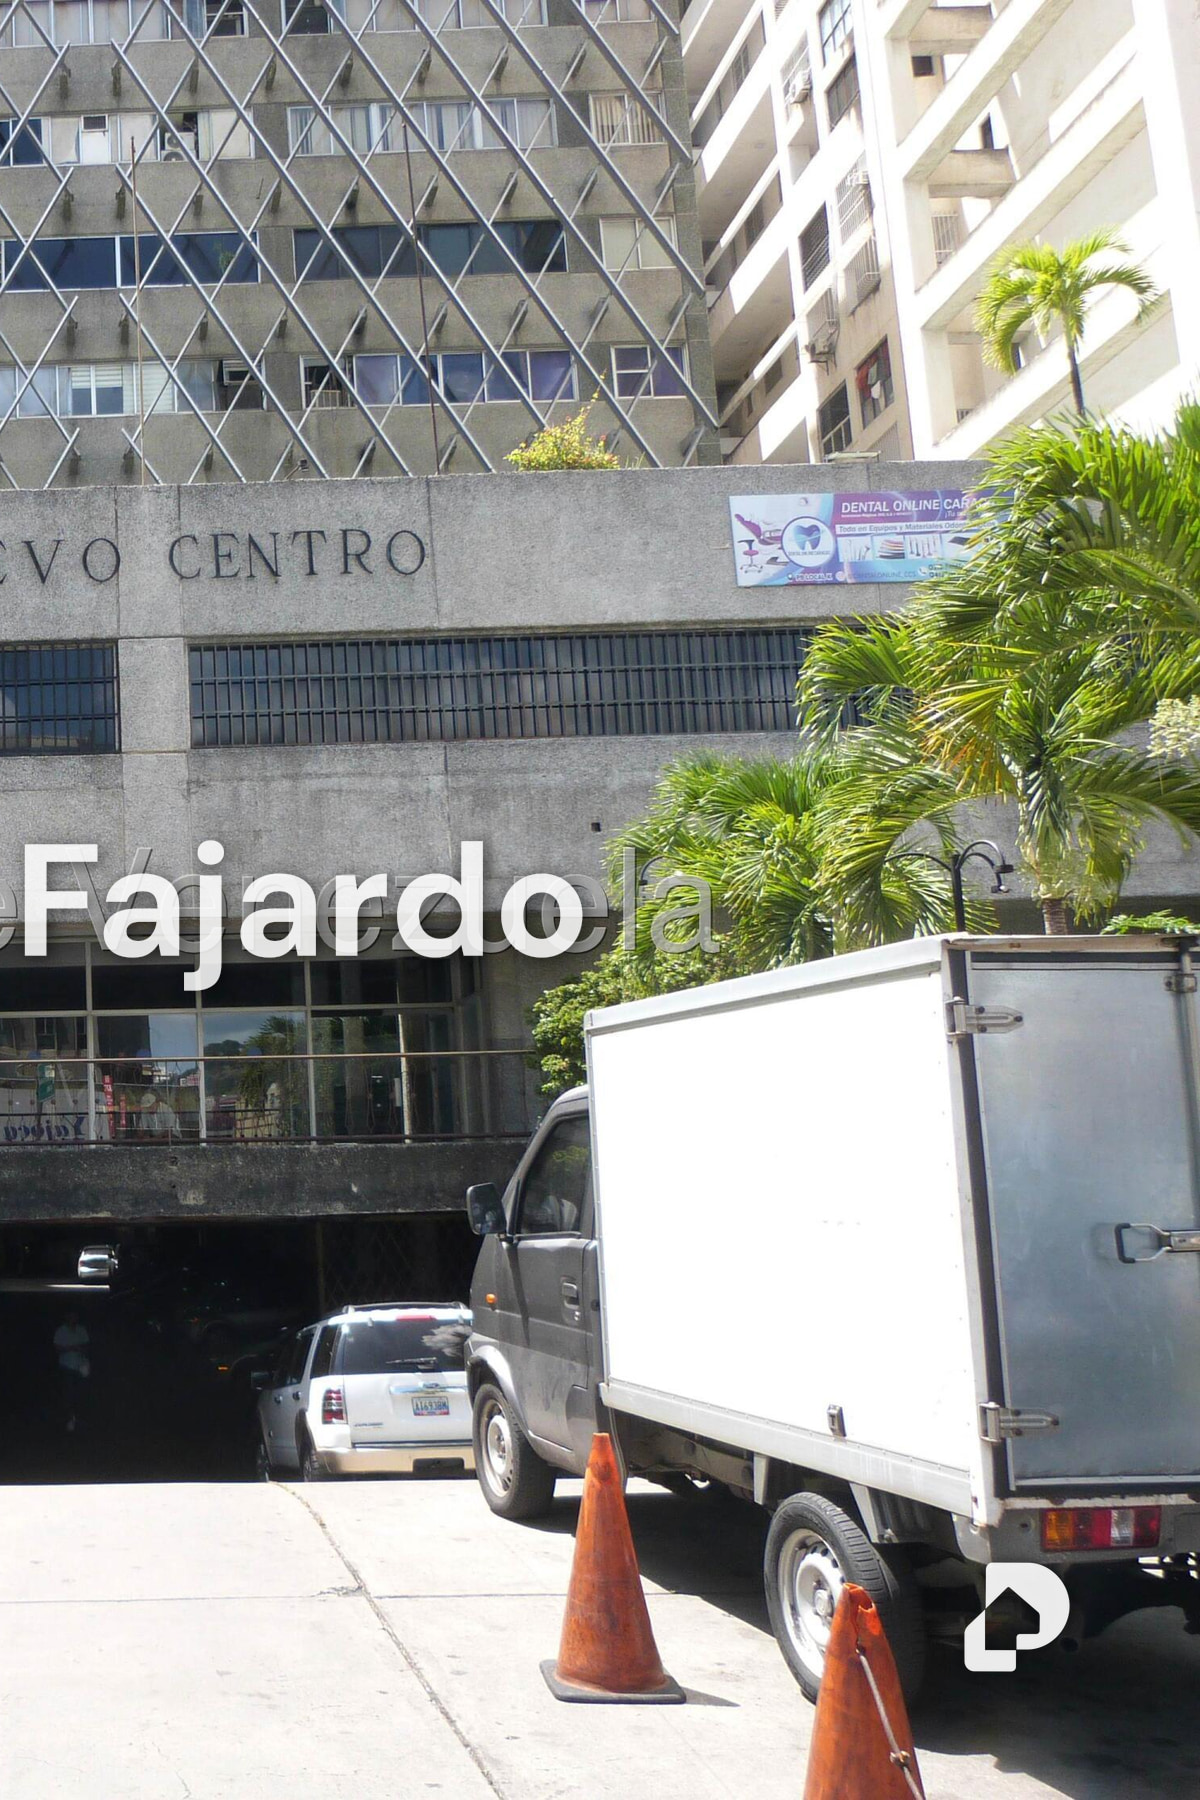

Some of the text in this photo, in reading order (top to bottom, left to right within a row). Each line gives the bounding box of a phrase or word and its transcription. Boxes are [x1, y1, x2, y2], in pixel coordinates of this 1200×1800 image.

[841, 501, 889, 514] DENTAL
[893, 500, 940, 512] ONLINE
[869, 524, 897, 533] Equipos
[905, 522, 943, 531] Materiales
[168, 529, 427, 582] CENTRO
